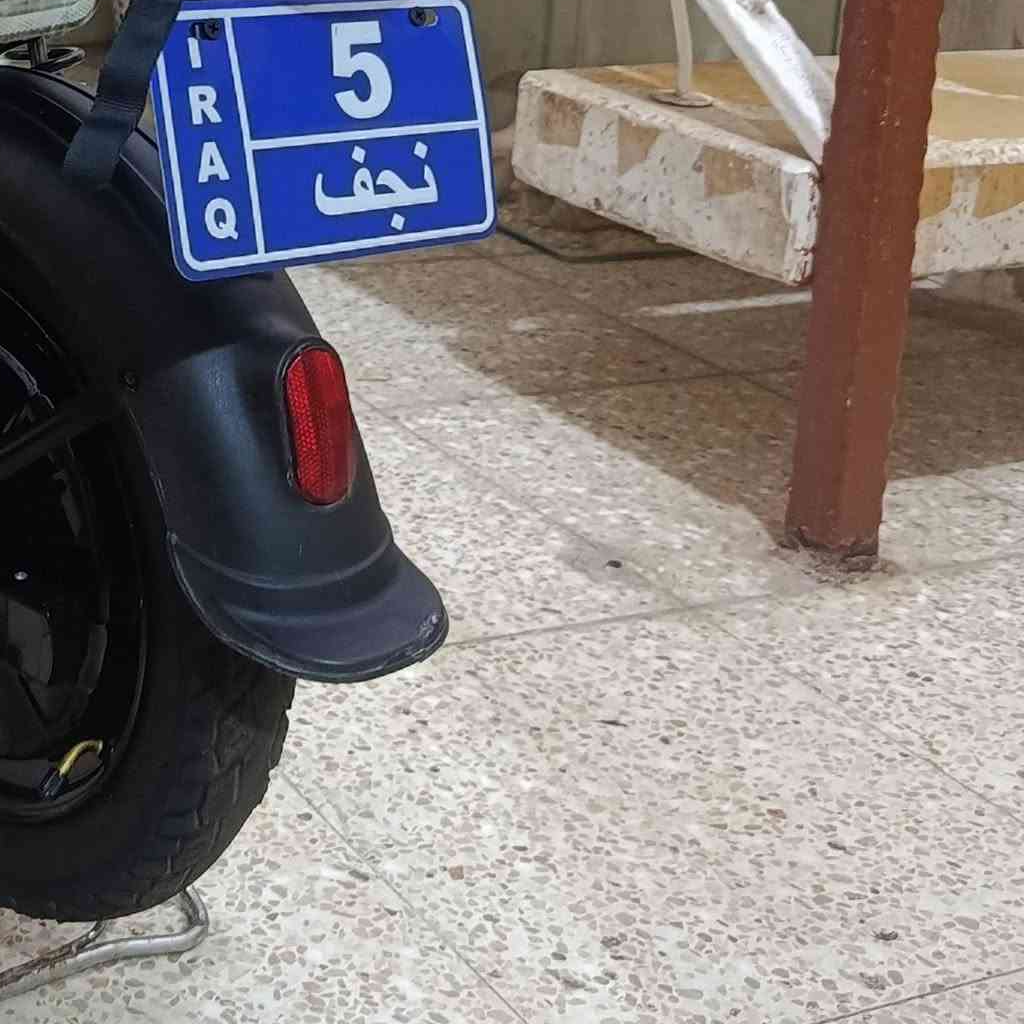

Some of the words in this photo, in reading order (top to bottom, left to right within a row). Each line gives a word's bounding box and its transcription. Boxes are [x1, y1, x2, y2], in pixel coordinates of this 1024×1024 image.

[331, 20, 393, 119] 5
[187, 25, 240, 241] IRAQ
[315, 141, 439, 231] نجف
